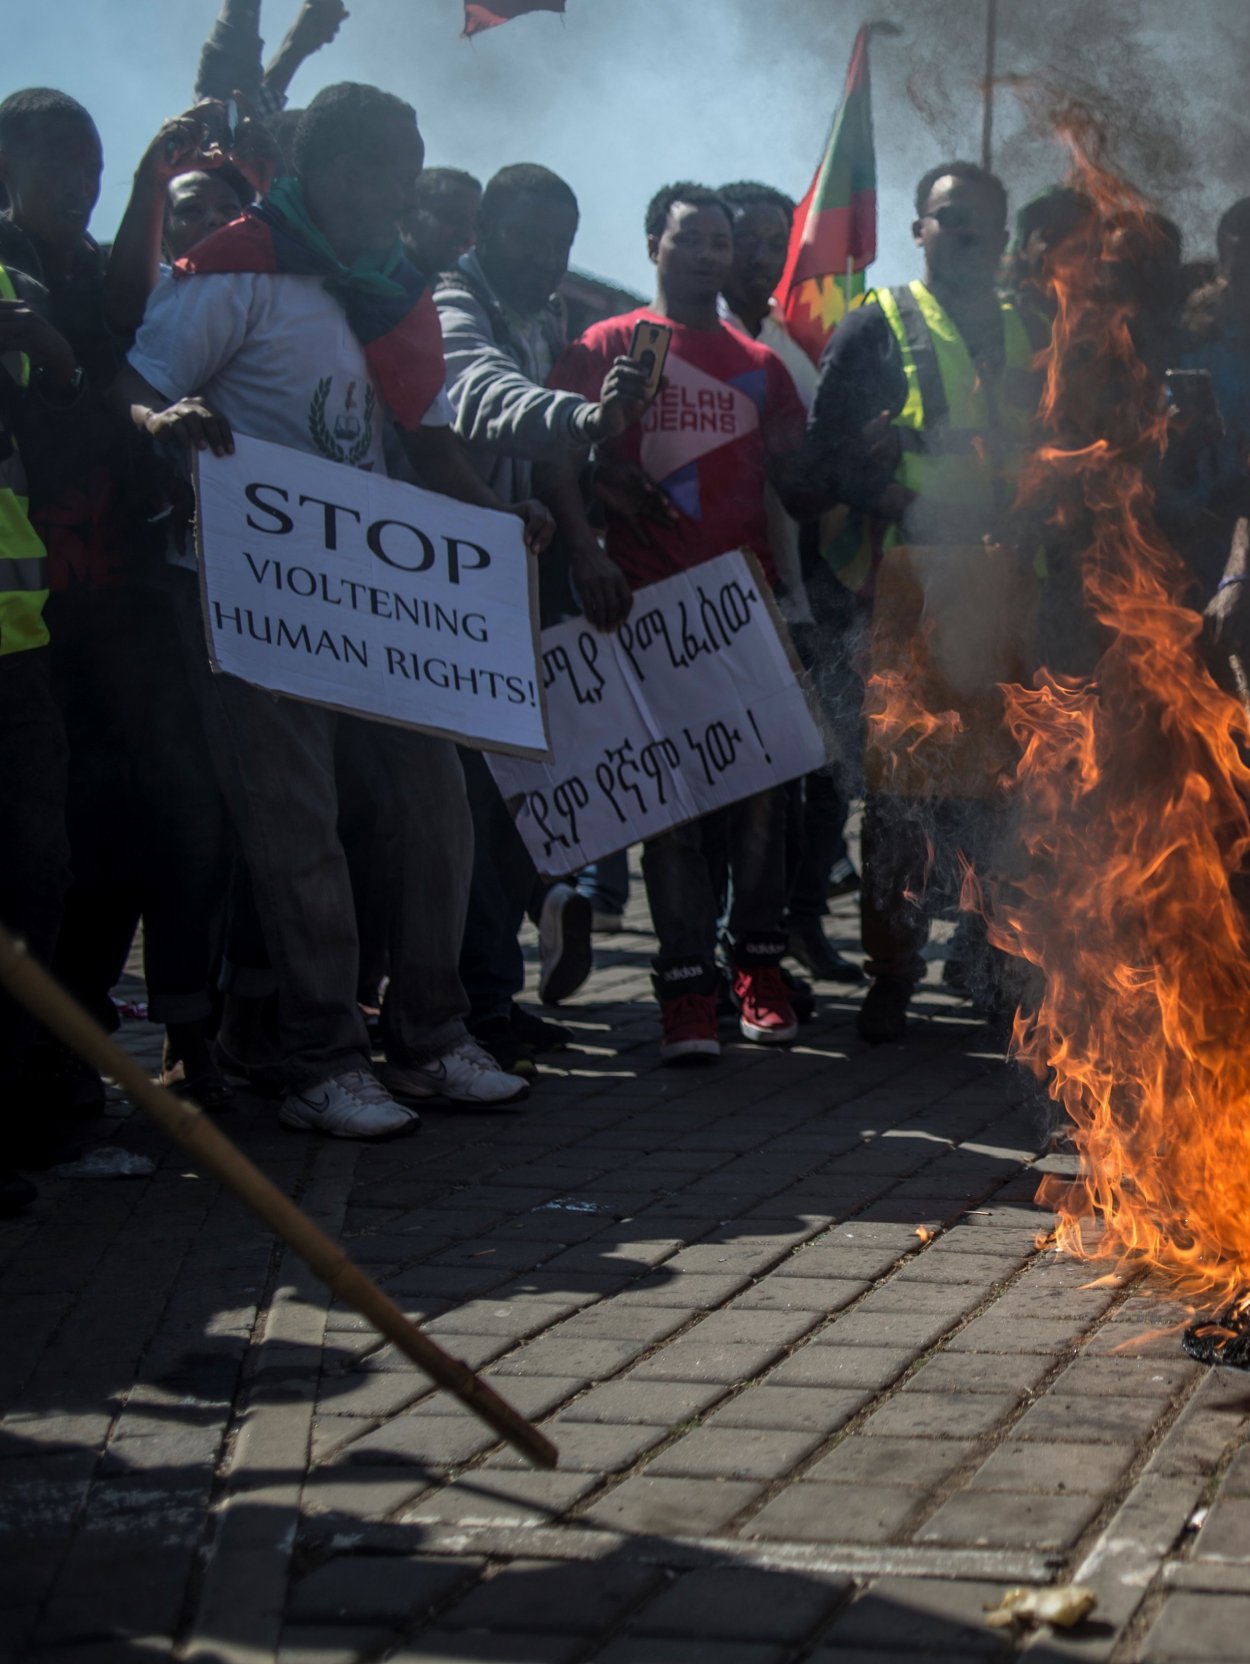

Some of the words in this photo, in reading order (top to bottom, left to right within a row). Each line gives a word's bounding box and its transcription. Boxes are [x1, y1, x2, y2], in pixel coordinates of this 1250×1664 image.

[643, 408, 736, 434] JEANS
[650, 384, 735, 411] ELAY
[244, 482, 491, 584] STOP
[242, 552, 489, 642] VIOLTENING
[212, 601, 369, 667] HUMAN
[385, 645, 538, 708] RIGHTS!
